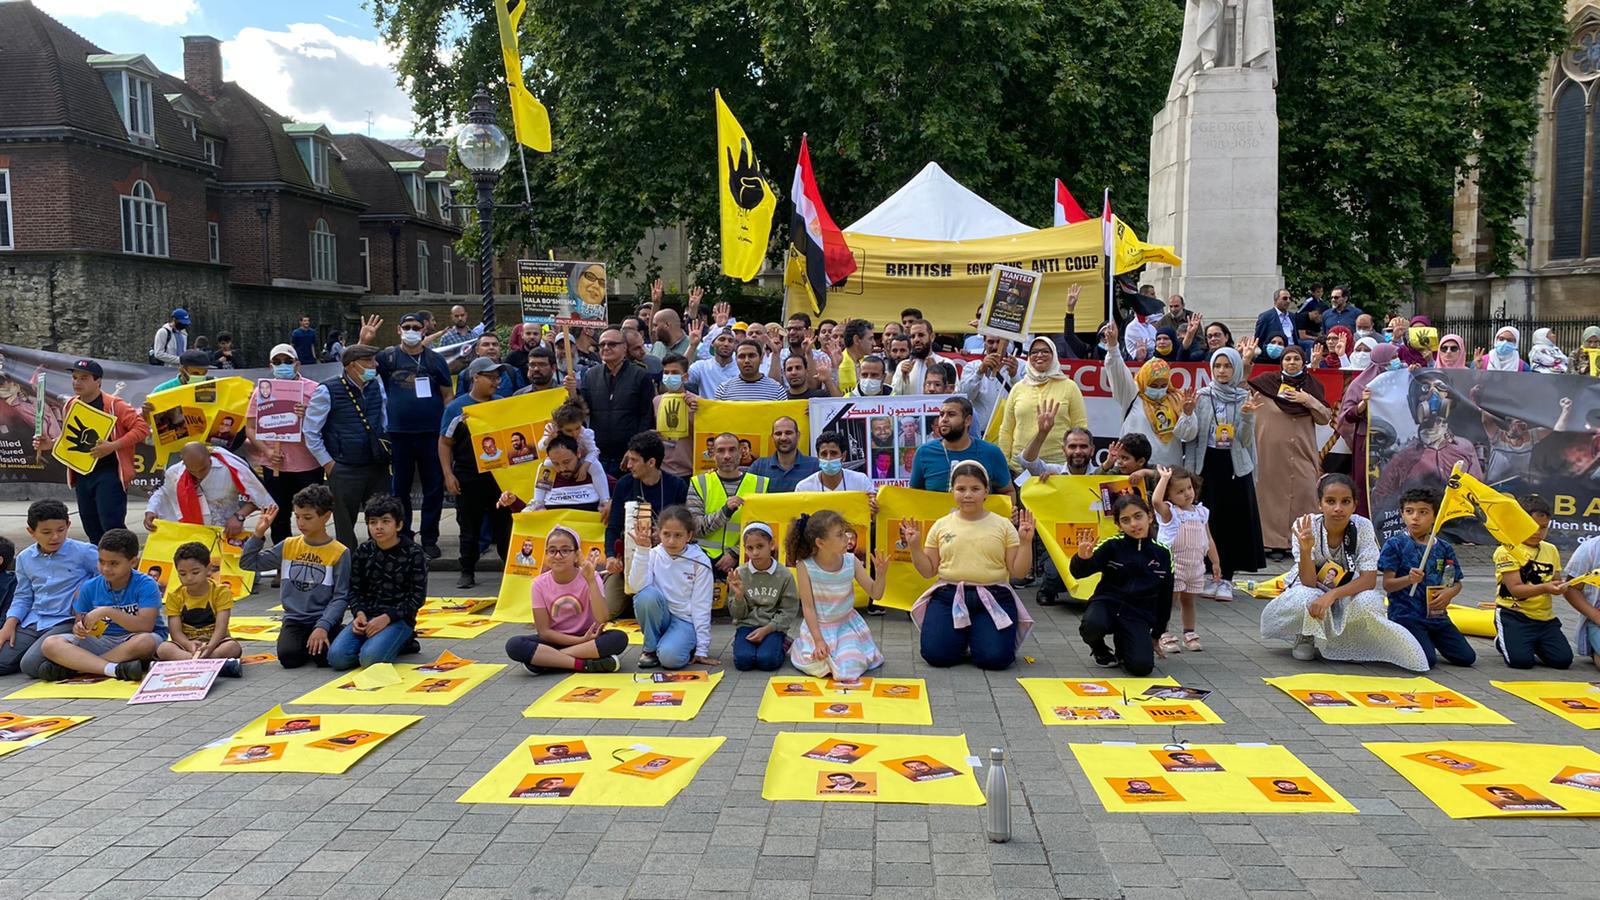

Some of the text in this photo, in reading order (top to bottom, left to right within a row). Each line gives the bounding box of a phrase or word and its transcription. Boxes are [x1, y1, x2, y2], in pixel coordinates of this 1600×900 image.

[1199, 119, 1266, 132] GEORGE V
[886, 263, 952, 278] BRITISH
[1031, 258, 1060, 273] ANTI
[1065, 255, 1099, 271] COUP
[521, 276, 568, 286] NOT JUST
[1002, 270, 1033, 283] WANTED
[522, 284, 569, 294] NUMBERS
[0, 439, 22, 448] illed
[0, 448, 24, 456] njured
[0, 456, 27, 465] issing
[131, 478, 148, 486] en
[1548, 519, 1579, 531] hen
[747, 587, 778, 598] PARIS
